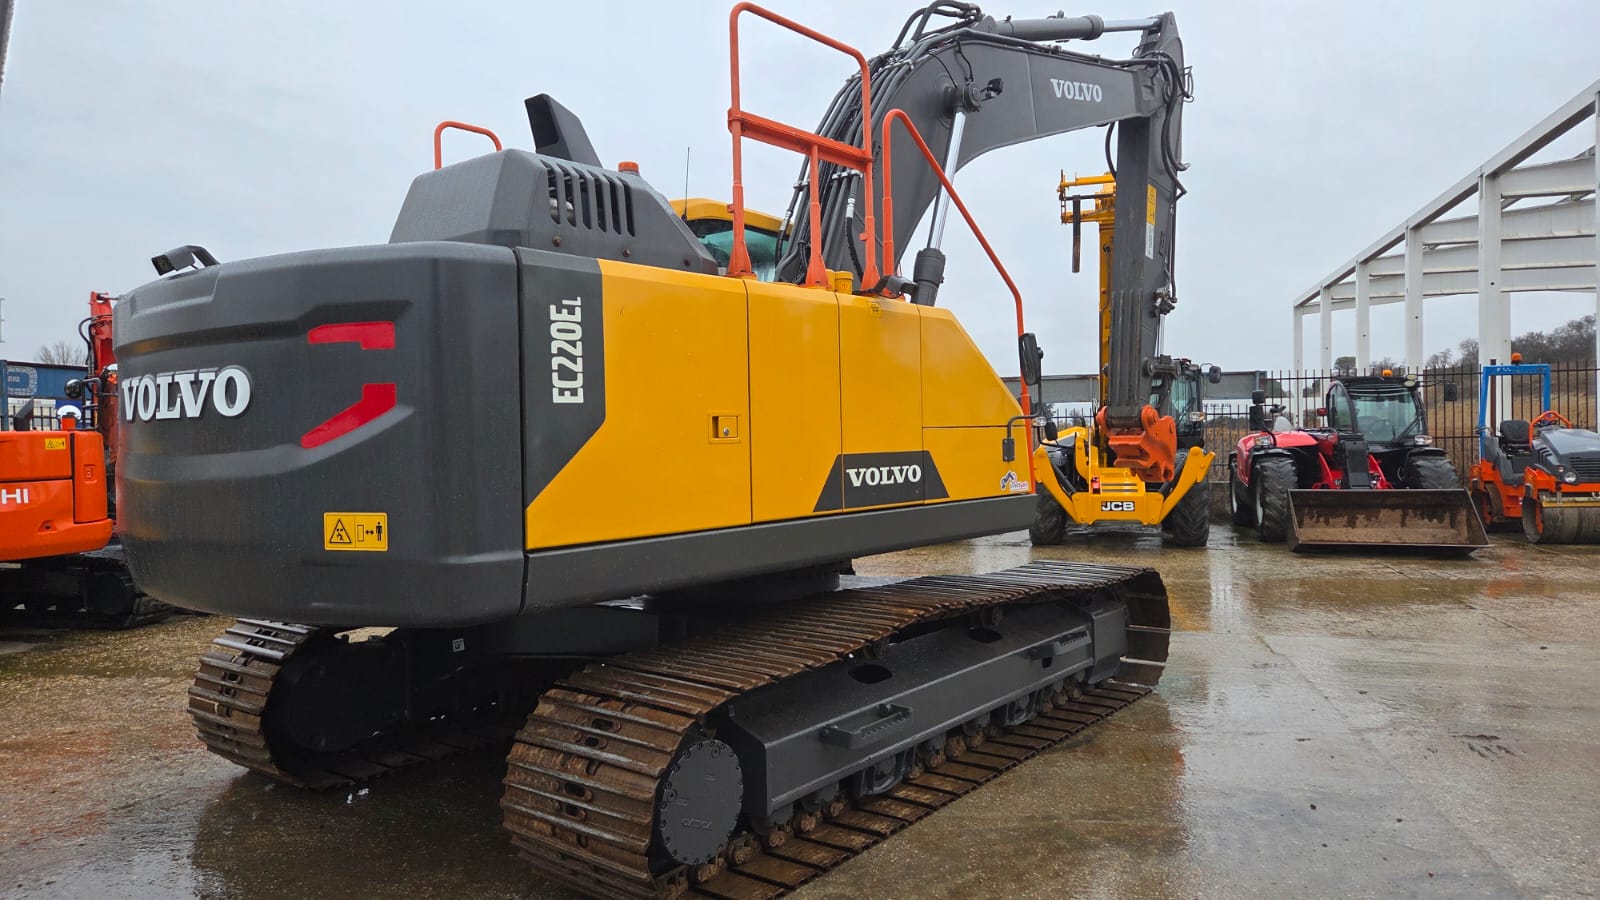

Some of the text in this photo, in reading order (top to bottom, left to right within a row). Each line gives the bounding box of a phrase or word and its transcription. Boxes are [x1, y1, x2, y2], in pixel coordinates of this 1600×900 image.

[1050, 78, 1103, 103] VOLVO
[122, 367, 251, 421] VOLVO
[846, 464, 922, 487] VOLVO
[1101, 501, 1135, 511] JCB
